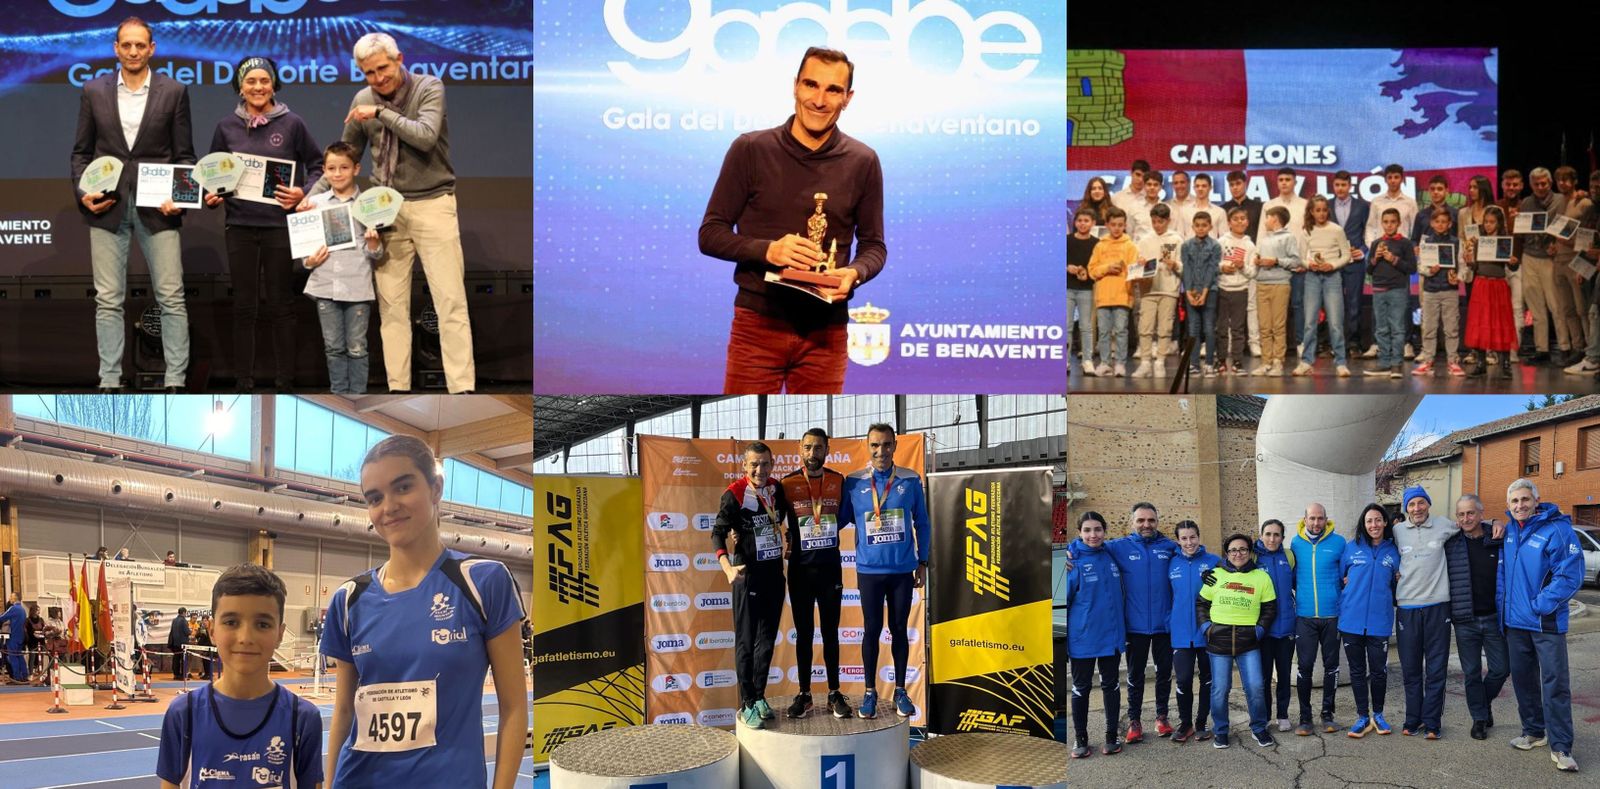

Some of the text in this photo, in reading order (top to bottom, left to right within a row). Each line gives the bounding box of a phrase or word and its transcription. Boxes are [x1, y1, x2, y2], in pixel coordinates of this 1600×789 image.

[214, 59, 338, 85] Dorte
[603, 107, 671, 130] Gala
[680, 107, 723, 131] del
[1170, 144, 1337, 165] CAMPEONES
[900, 323, 1063, 340] AYUNTAMIENTO
[900, 343, 1063, 359] DE BENAVENTE
[950, 637, 1025, 652] gafatletismo.eu
[532, 650, 616, 665] gafatletismo.eu
[368, 711, 422, 742] 4597
[825, 761, 847, 789] 1
